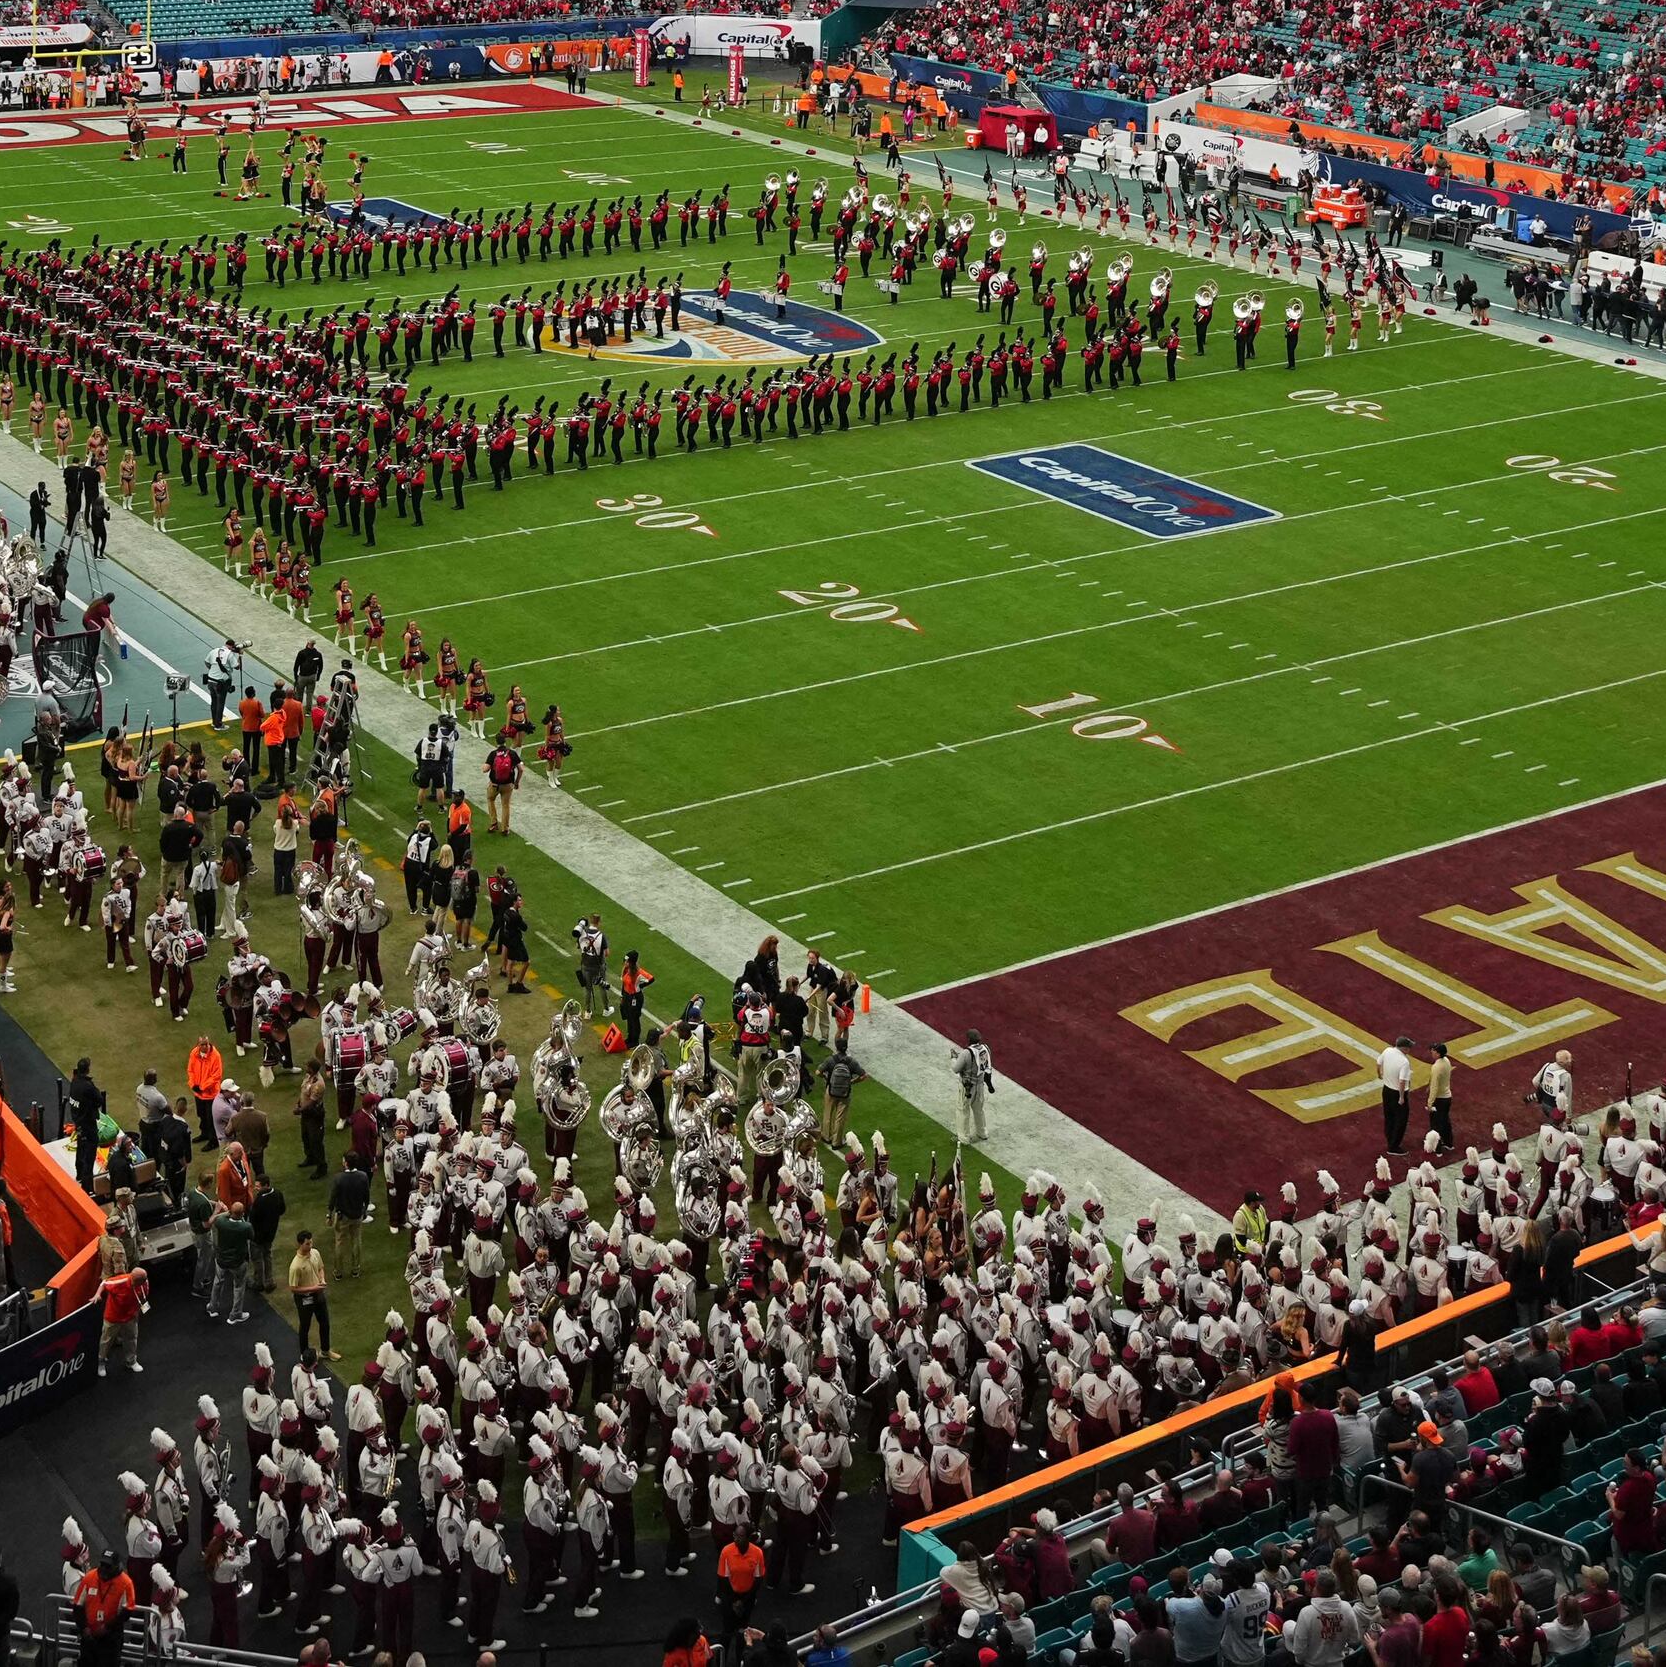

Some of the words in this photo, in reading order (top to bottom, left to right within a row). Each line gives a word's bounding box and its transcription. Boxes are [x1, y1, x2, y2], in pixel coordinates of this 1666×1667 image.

[1287, 388, 1379, 418] 30
[1505, 454, 1617, 487] 20
[595, 493, 699, 532] 30
[1018, 454, 1208, 531] CapitalOne
[779, 581, 900, 623] 20
[1017, 691, 1148, 740] 10
